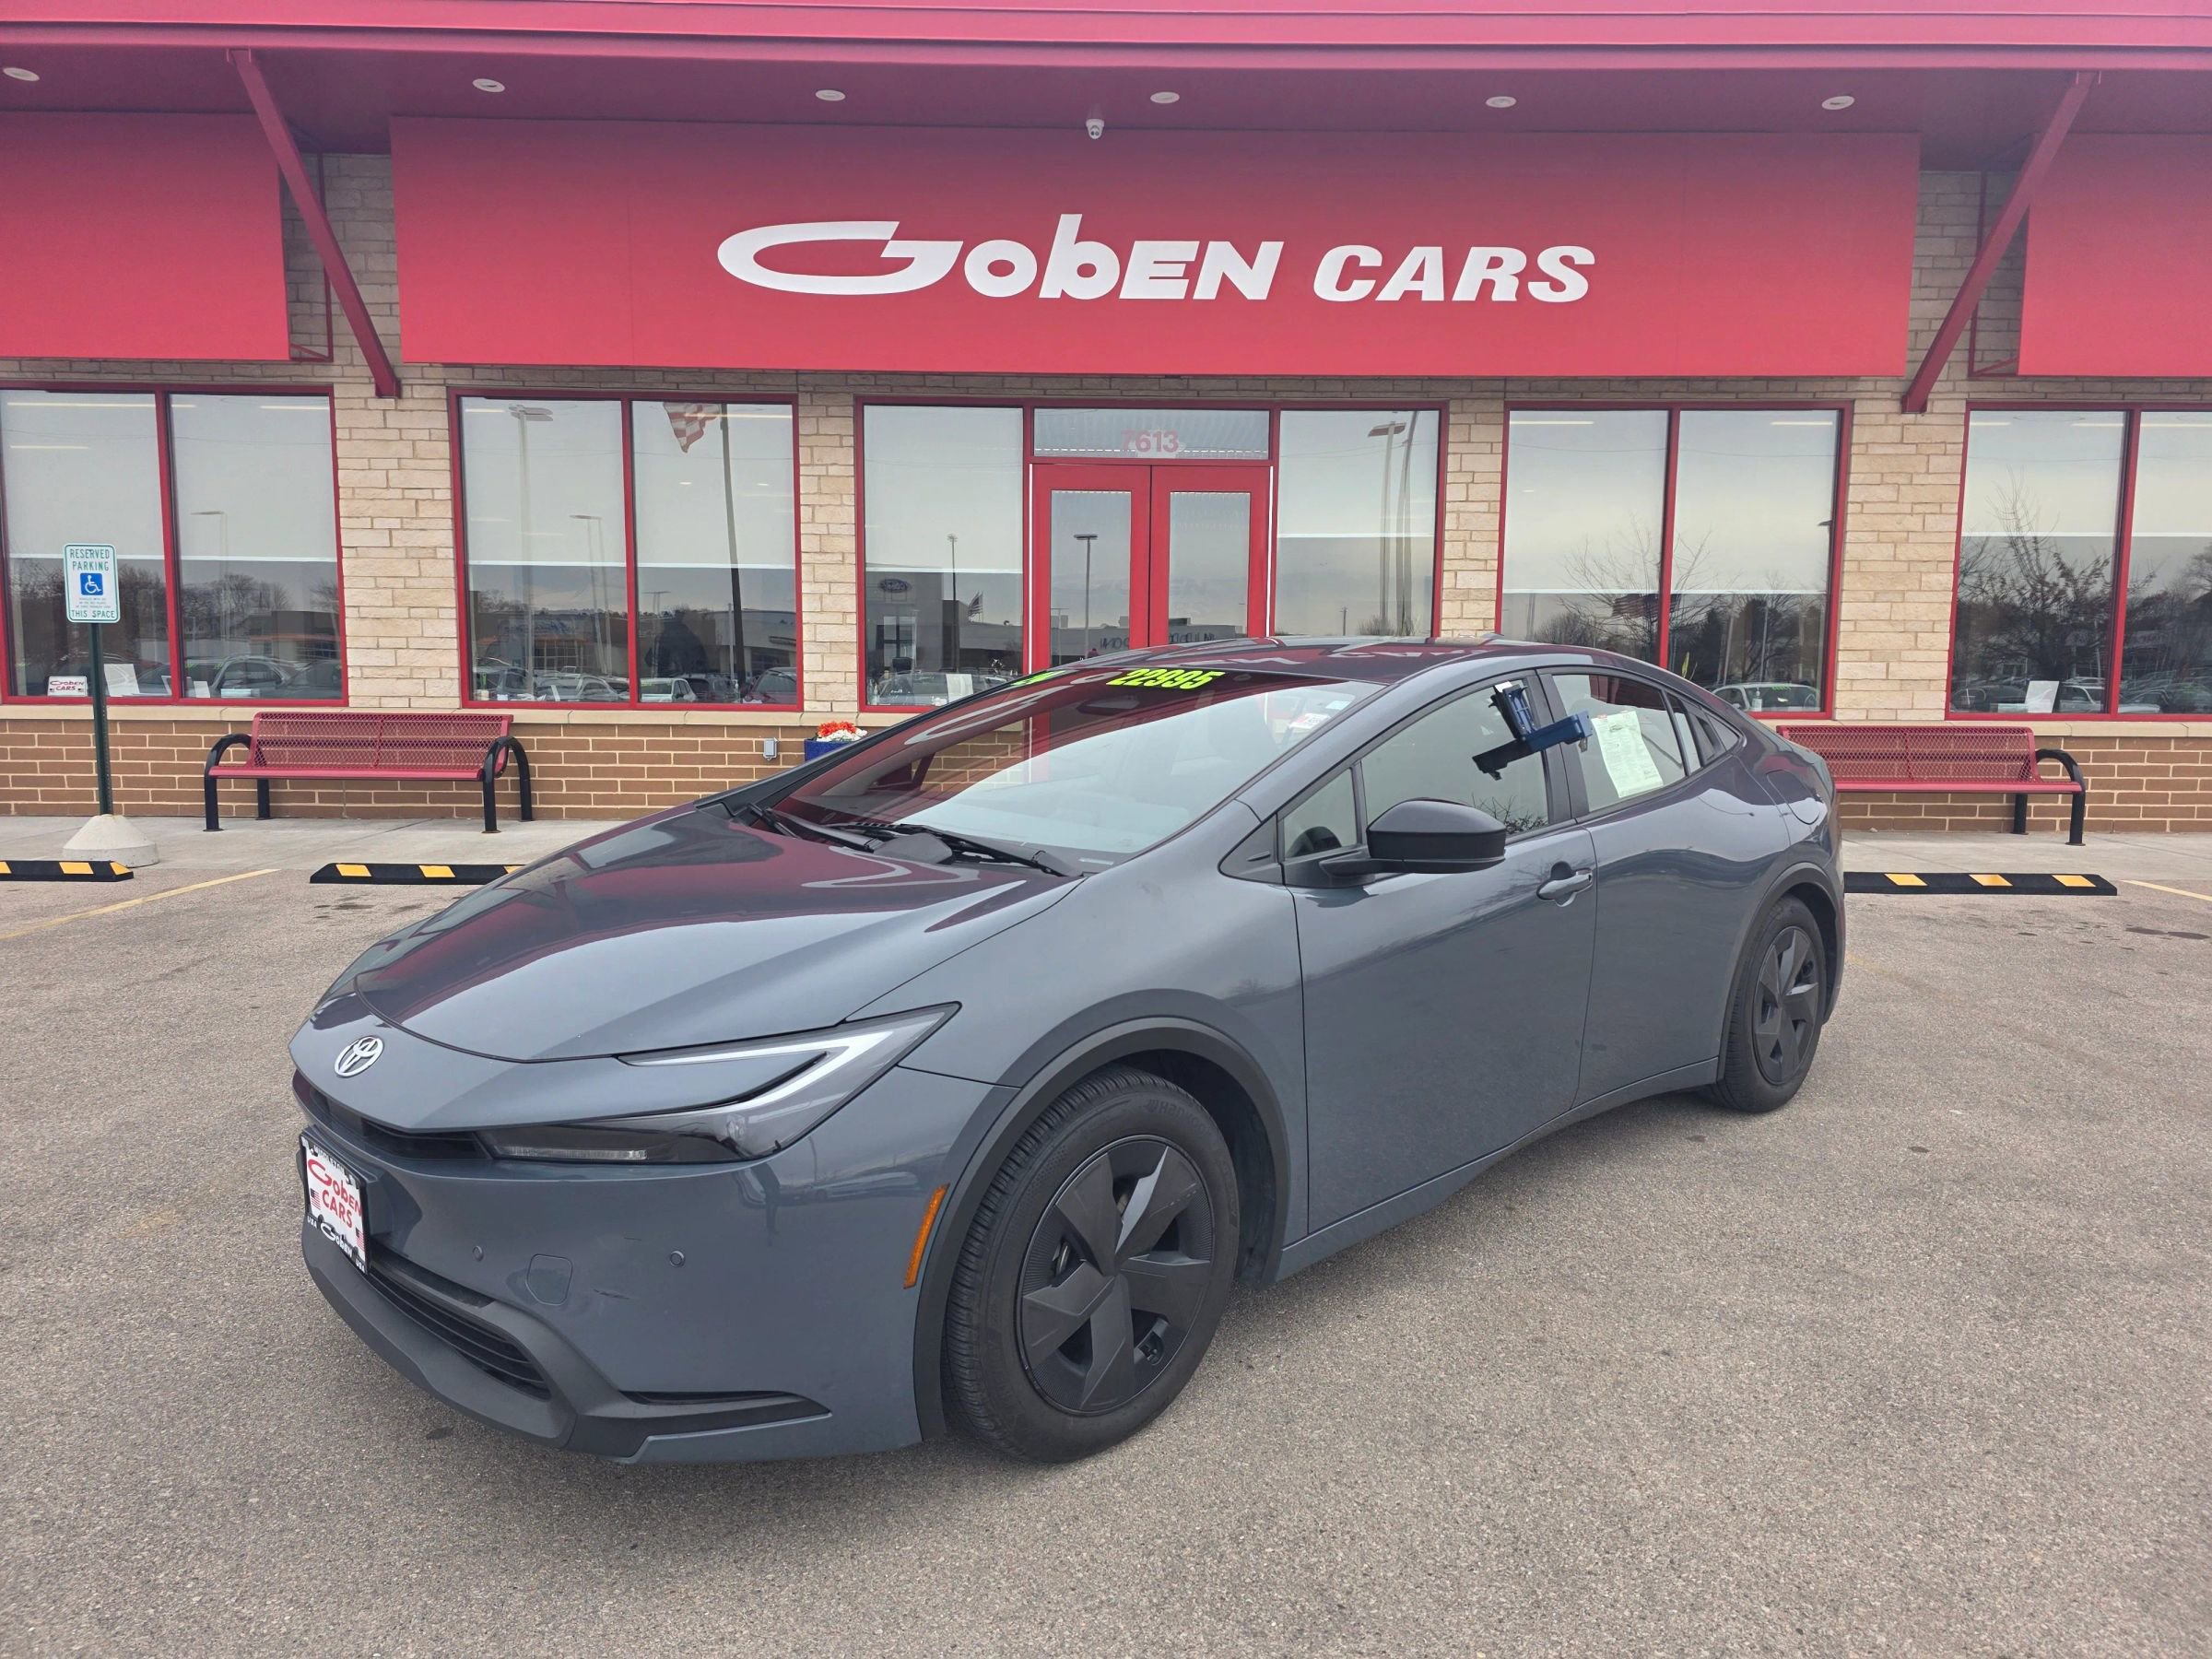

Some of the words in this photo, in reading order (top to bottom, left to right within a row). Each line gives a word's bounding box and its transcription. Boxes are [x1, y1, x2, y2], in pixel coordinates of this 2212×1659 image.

[1313, 244, 1595, 302] CARS
[70, 548, 110, 559] RESERVED
[73, 561, 109, 571] PARKING
[1106, 668, 1226, 689] 22995
[323, 1190, 352, 1229] CARS
